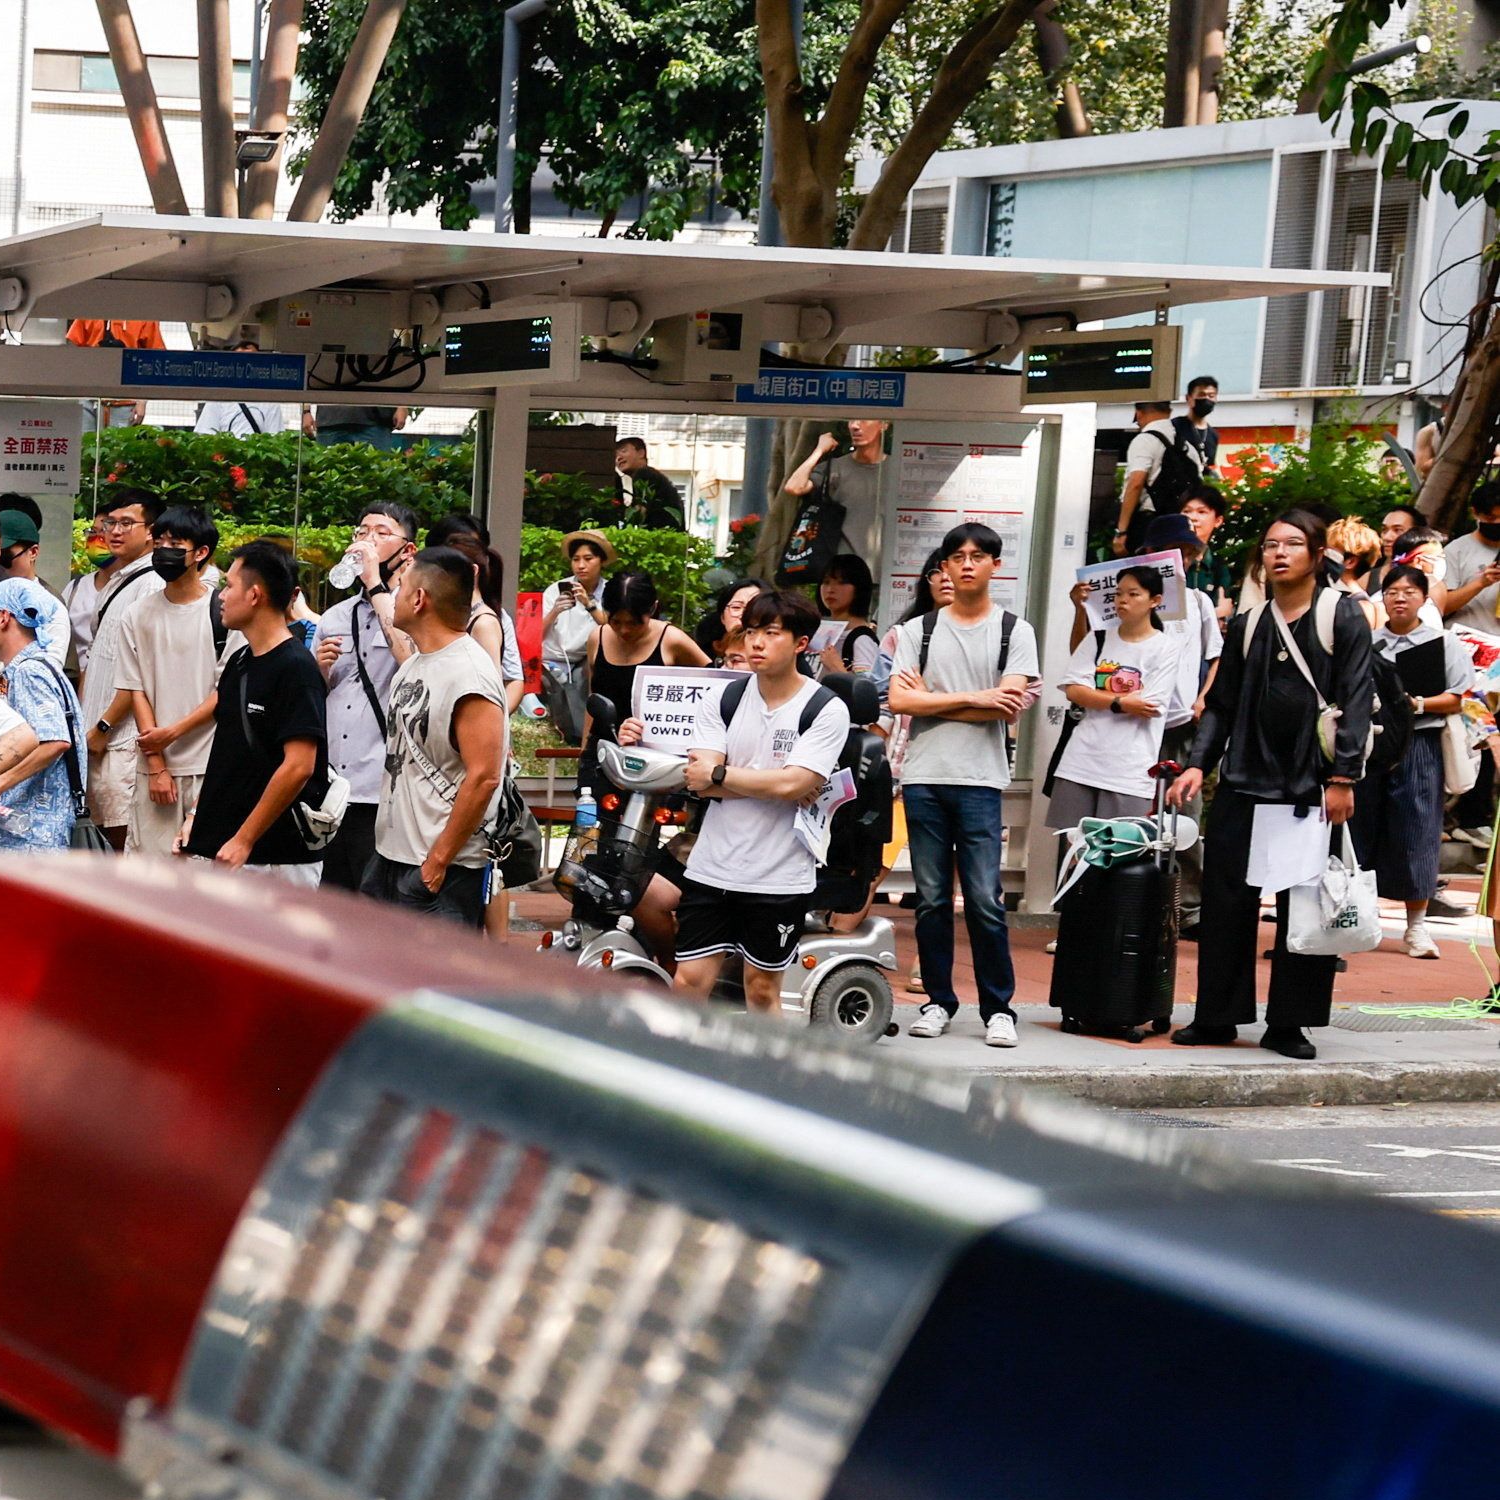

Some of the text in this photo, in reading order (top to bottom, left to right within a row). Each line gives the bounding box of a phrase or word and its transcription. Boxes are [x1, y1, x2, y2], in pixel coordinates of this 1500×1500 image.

[3, 437, 69, 455] 全面禁菸
[903, 449, 917, 457] 231
[645, 684, 711, 704] 尊嚴不
[644, 713, 662, 722] WE
[651, 726, 680, 736] OWN
